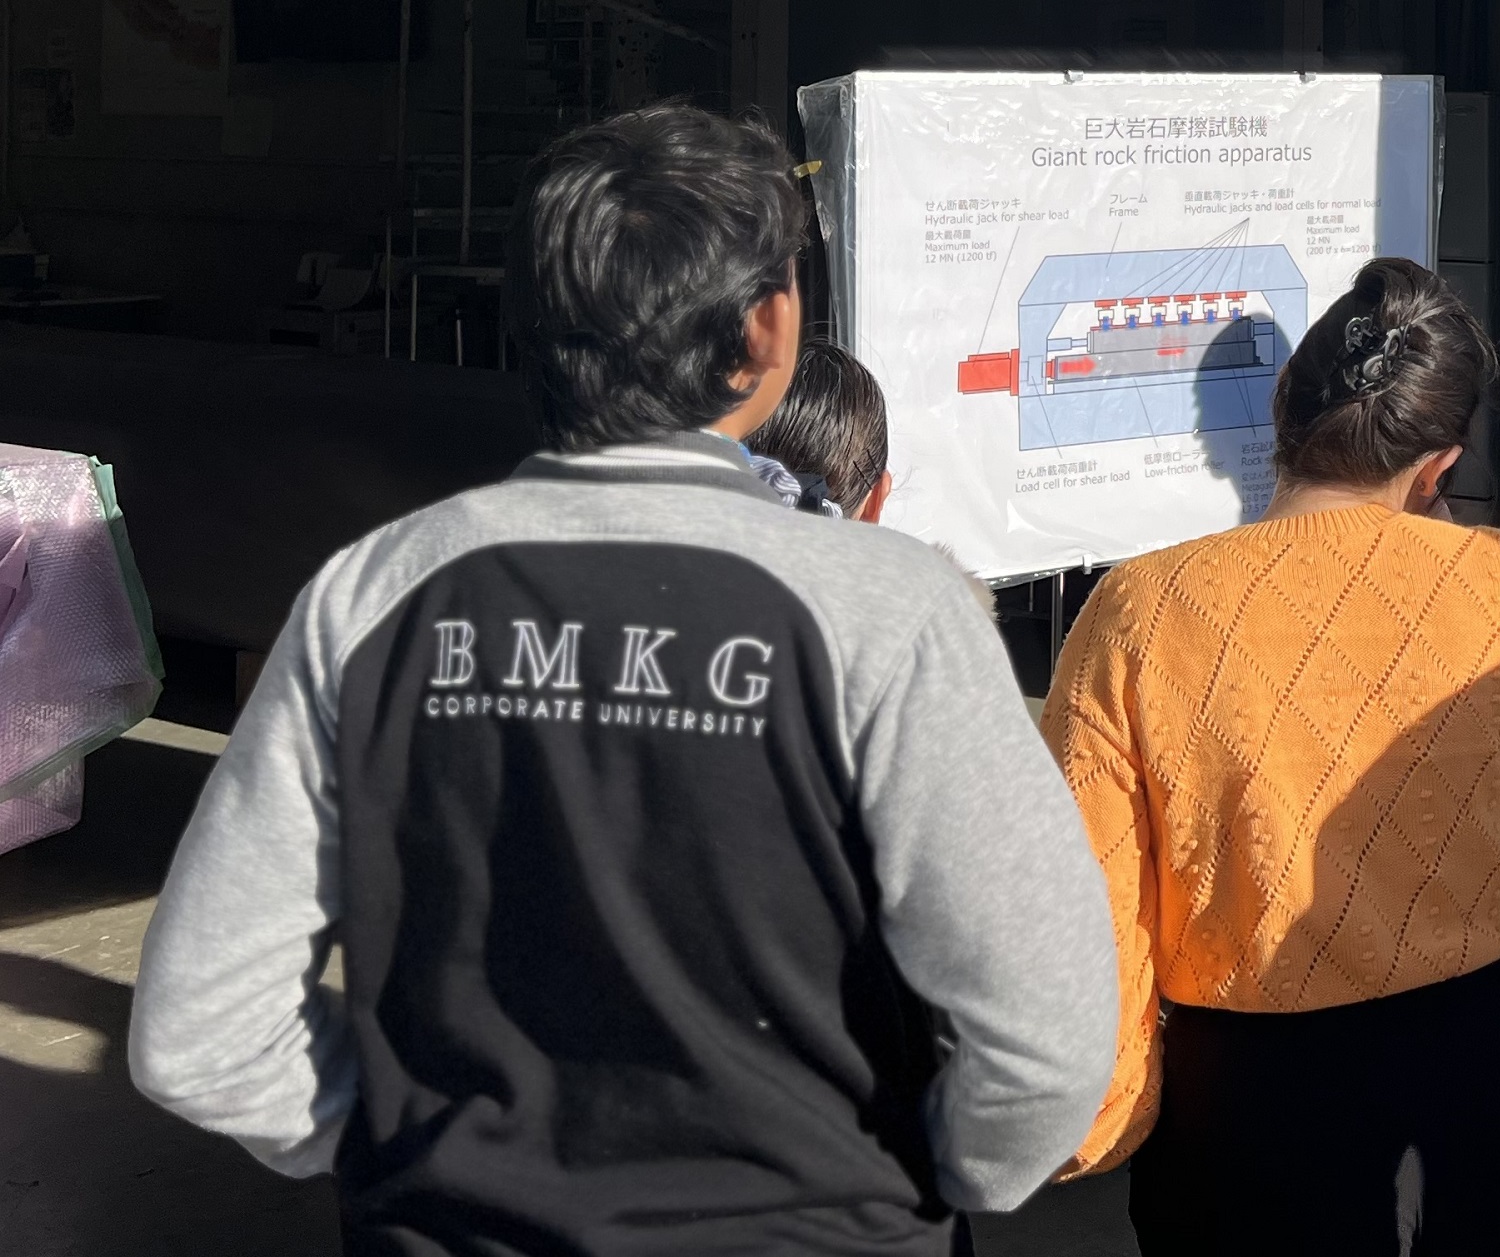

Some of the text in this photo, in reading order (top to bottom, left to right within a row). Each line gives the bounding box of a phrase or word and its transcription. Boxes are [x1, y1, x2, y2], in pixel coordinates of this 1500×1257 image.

[1084, 116, 1268, 140] 巨大岩石摩擦試験機
[1031, 144, 1313, 167] Giant rock friction apparatus
[1109, 193, 1148, 205] フレーム
[1108, 207, 1139, 217] Frame
[1184, 198, 1382, 216] Hydraulic jacks and load cells for normal load
[925, 209, 1069, 227] Hydraulic jack for shear load
[1306, 224, 1360, 234] Maximum load
[925, 240, 990, 252] Maximum load
[925, 254, 937, 263] 12
[939, 253, 954, 263] MN
[957, 251, 983, 264] (1200
[1241, 456, 1262, 466] Rock
[1144, 464, 1199, 478] Low-friction
[1015, 470, 1130, 493] Load cell for shear load
[424, 696, 766, 737] CORPORATE UNIVERSITY
